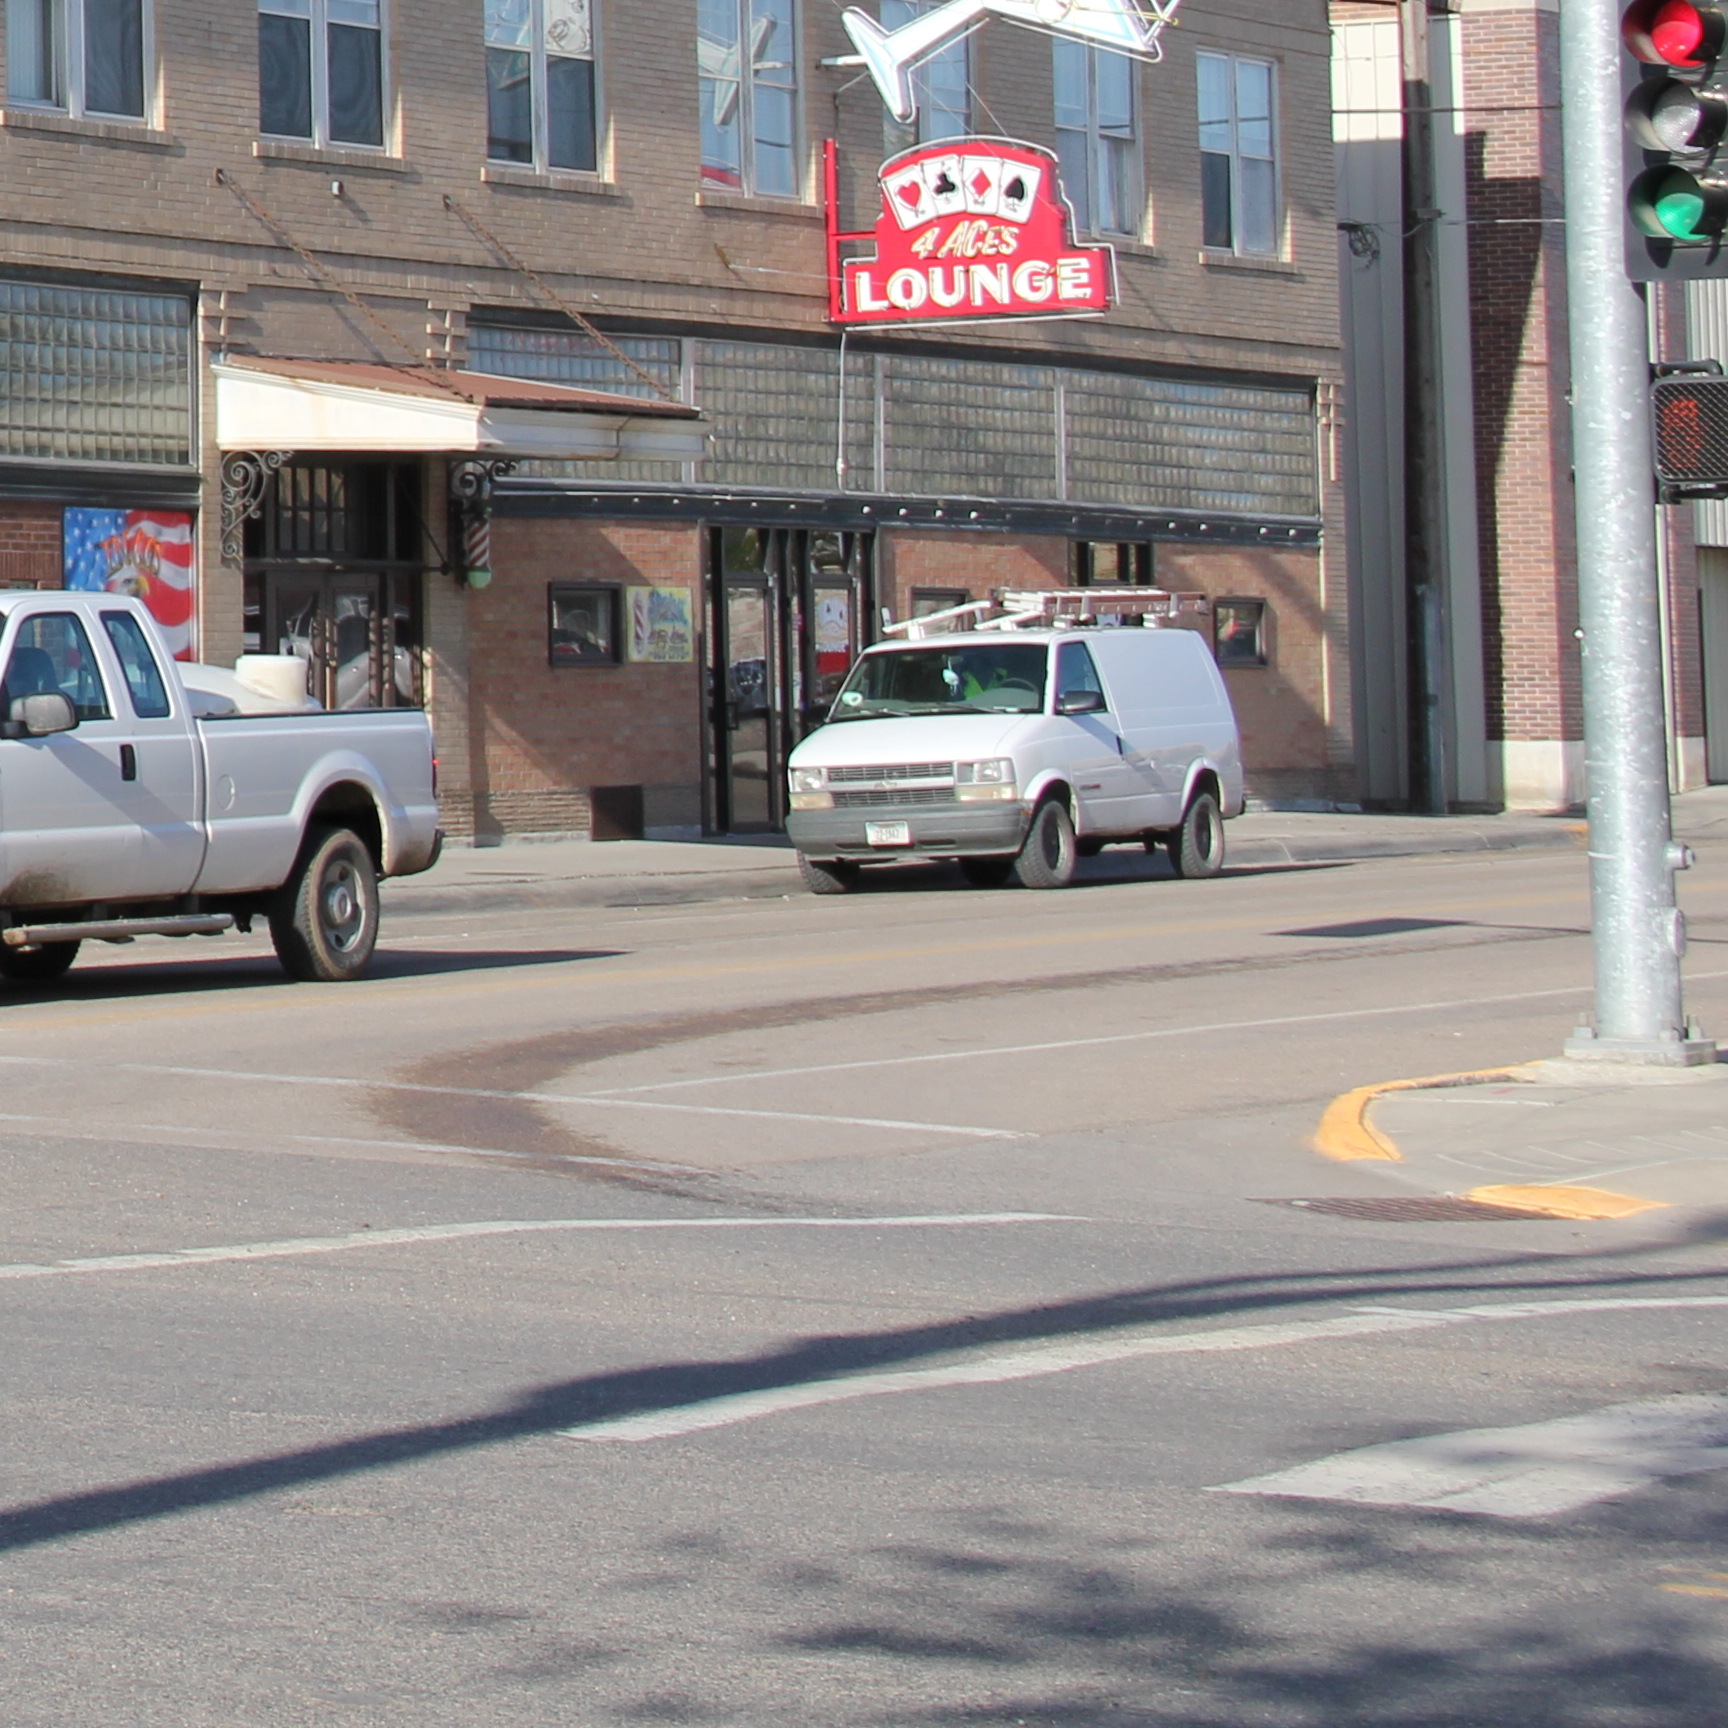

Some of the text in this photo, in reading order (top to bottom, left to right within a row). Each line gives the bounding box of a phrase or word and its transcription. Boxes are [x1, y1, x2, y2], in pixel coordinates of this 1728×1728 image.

[911, 219, 1020, 260] 4 ACES
[856, 257, 1093, 313] LOUNGE
